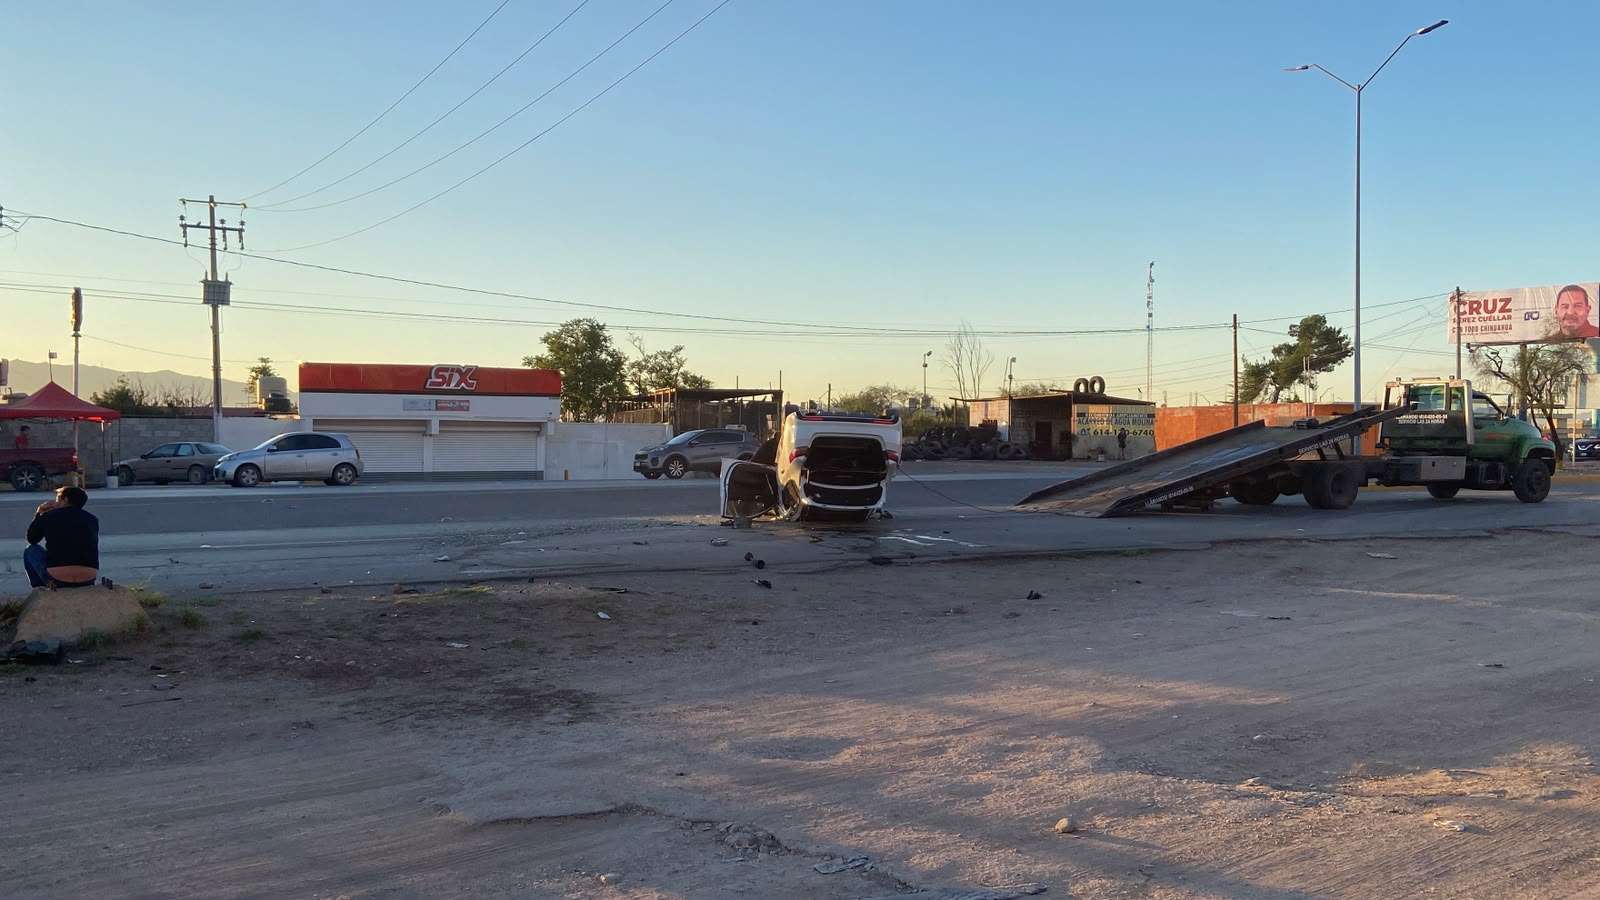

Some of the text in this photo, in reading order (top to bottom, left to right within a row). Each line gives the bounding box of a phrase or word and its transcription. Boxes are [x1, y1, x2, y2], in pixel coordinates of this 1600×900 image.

[1453, 298, 1512, 316] CRUZ
[1114, 417, 1131, 426] AGUA
[1093, 428, 1155, 437] 614-10-6740
